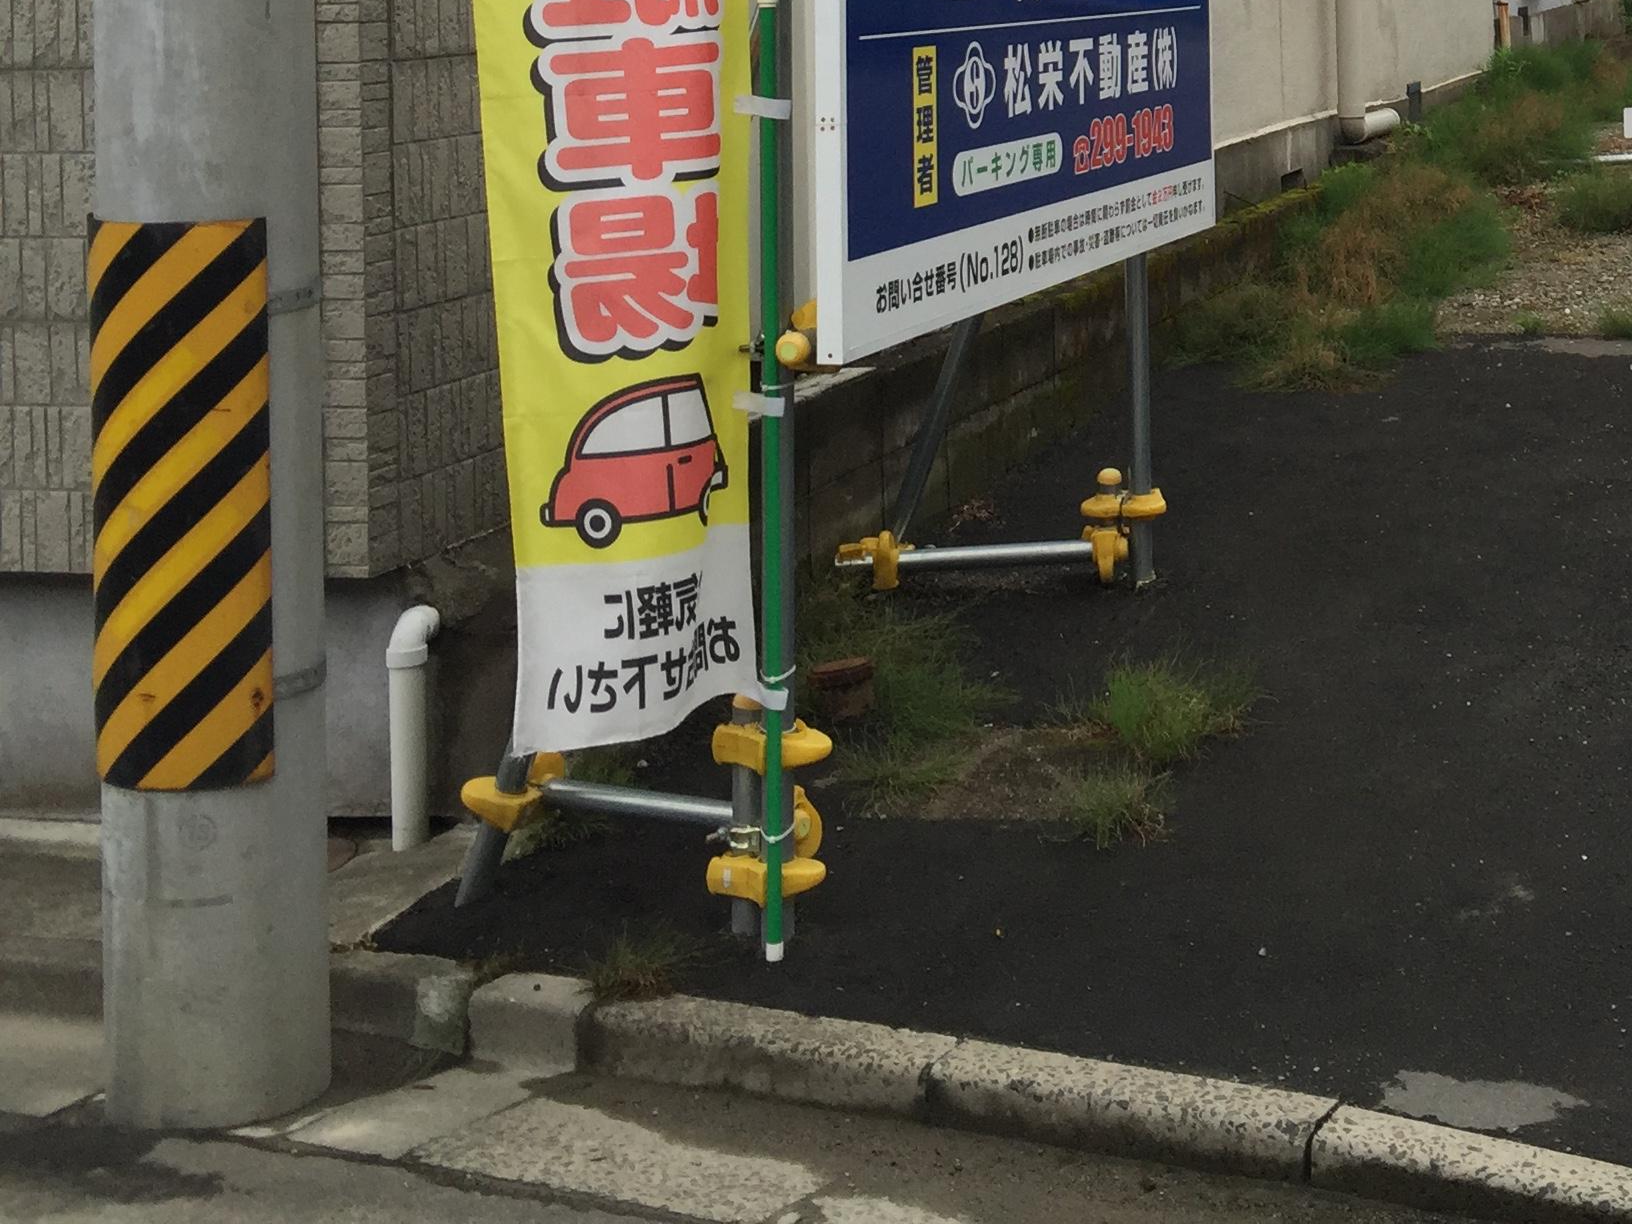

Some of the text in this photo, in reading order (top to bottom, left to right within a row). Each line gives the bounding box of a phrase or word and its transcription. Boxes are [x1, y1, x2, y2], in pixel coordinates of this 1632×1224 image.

[915, 54, 935, 196] 管理者
[961, 139, 1056, 188] パーキング専用
